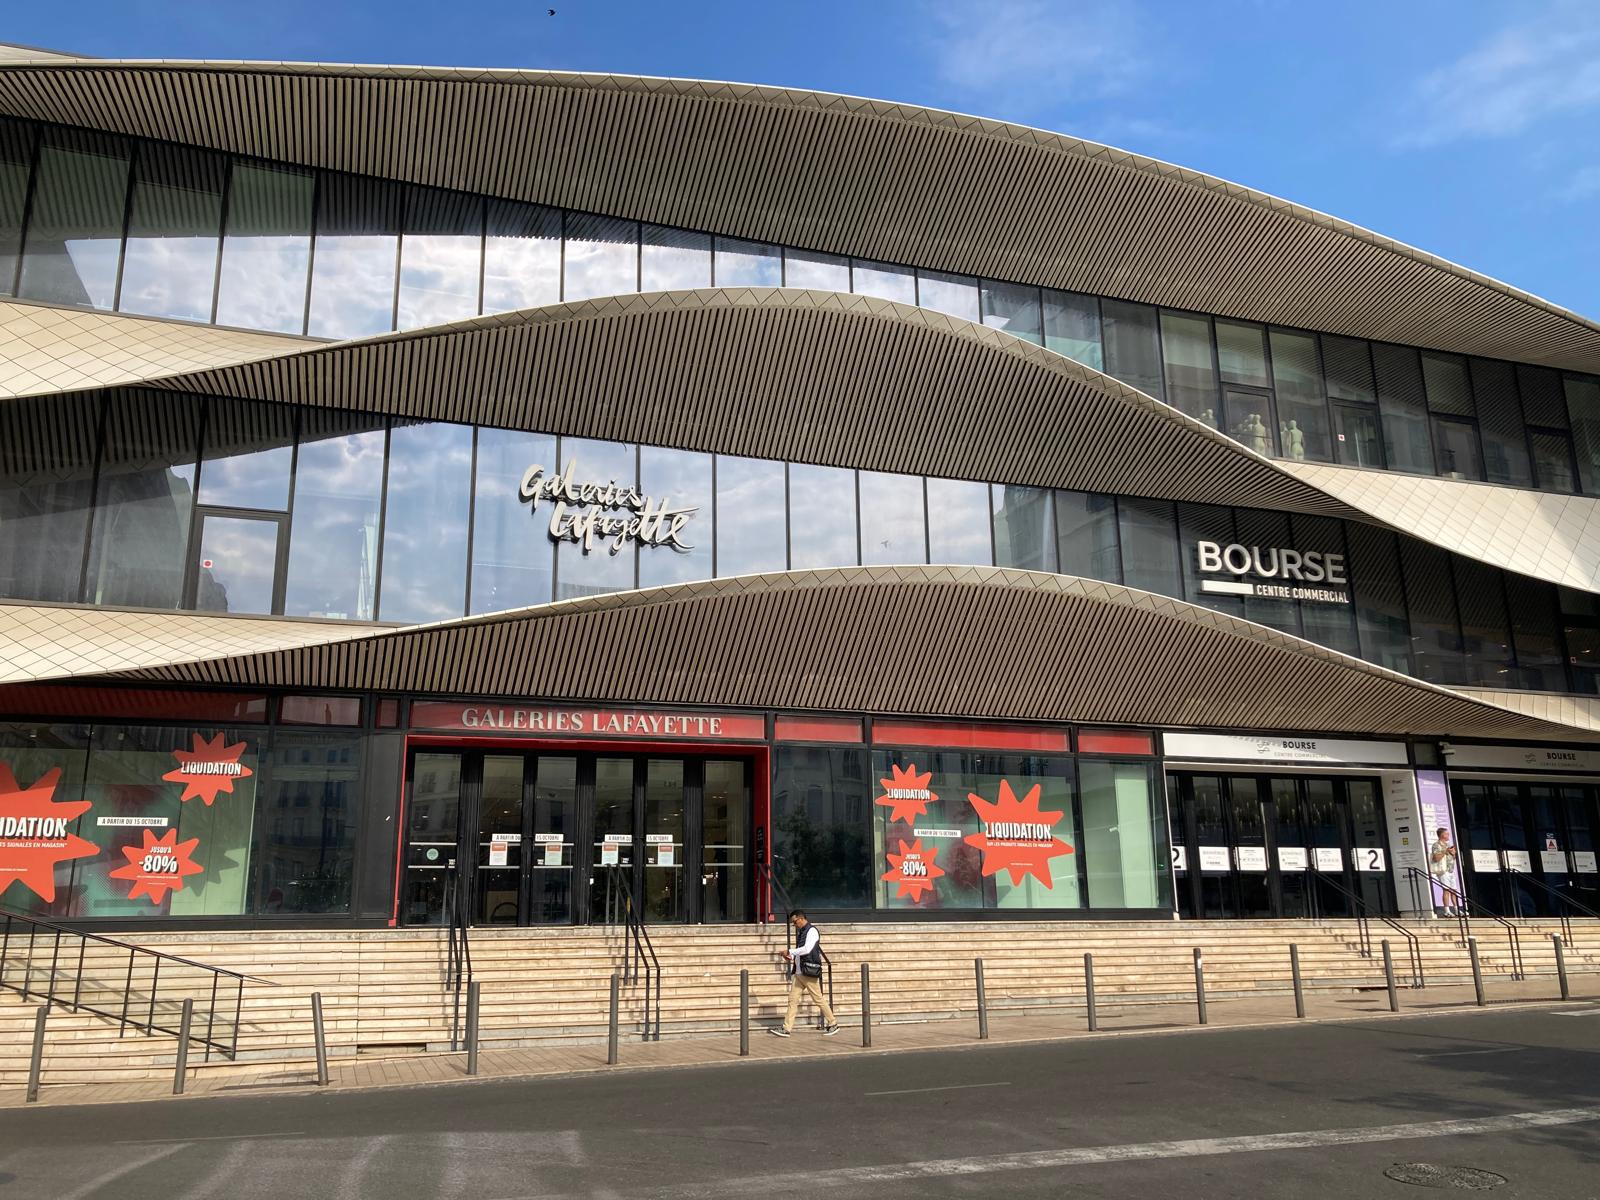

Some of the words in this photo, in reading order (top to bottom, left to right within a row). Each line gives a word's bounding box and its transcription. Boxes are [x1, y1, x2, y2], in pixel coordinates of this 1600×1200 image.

[519, 458, 643, 510] Galeries
[549, 495, 700, 552] Lafayette
[1197, 540, 1347, 584] BOURSE
[1256, 584, 1290, 598] CENTRE
[1292, 587, 1350, 604] COMMERCIAL
[461, 708, 584, 731] GALERIES
[592, 713, 723, 735] LAFAYETTE
[1282, 740, 1316, 750] BOURSE
[1546, 752, 1576, 761] BOURSE
[180, 760, 242, 776] LIQUIDATION
[887, 788, 931, 800] LIQUIDATION
[985, 822, 1053, 841] LIQUIDATION
[138, 854, 179, 874] -80%
[1172, 847, 1182, 869] 2
[1367, 849, 1381, 870] 2
[899, 861, 928, 876] -80%
